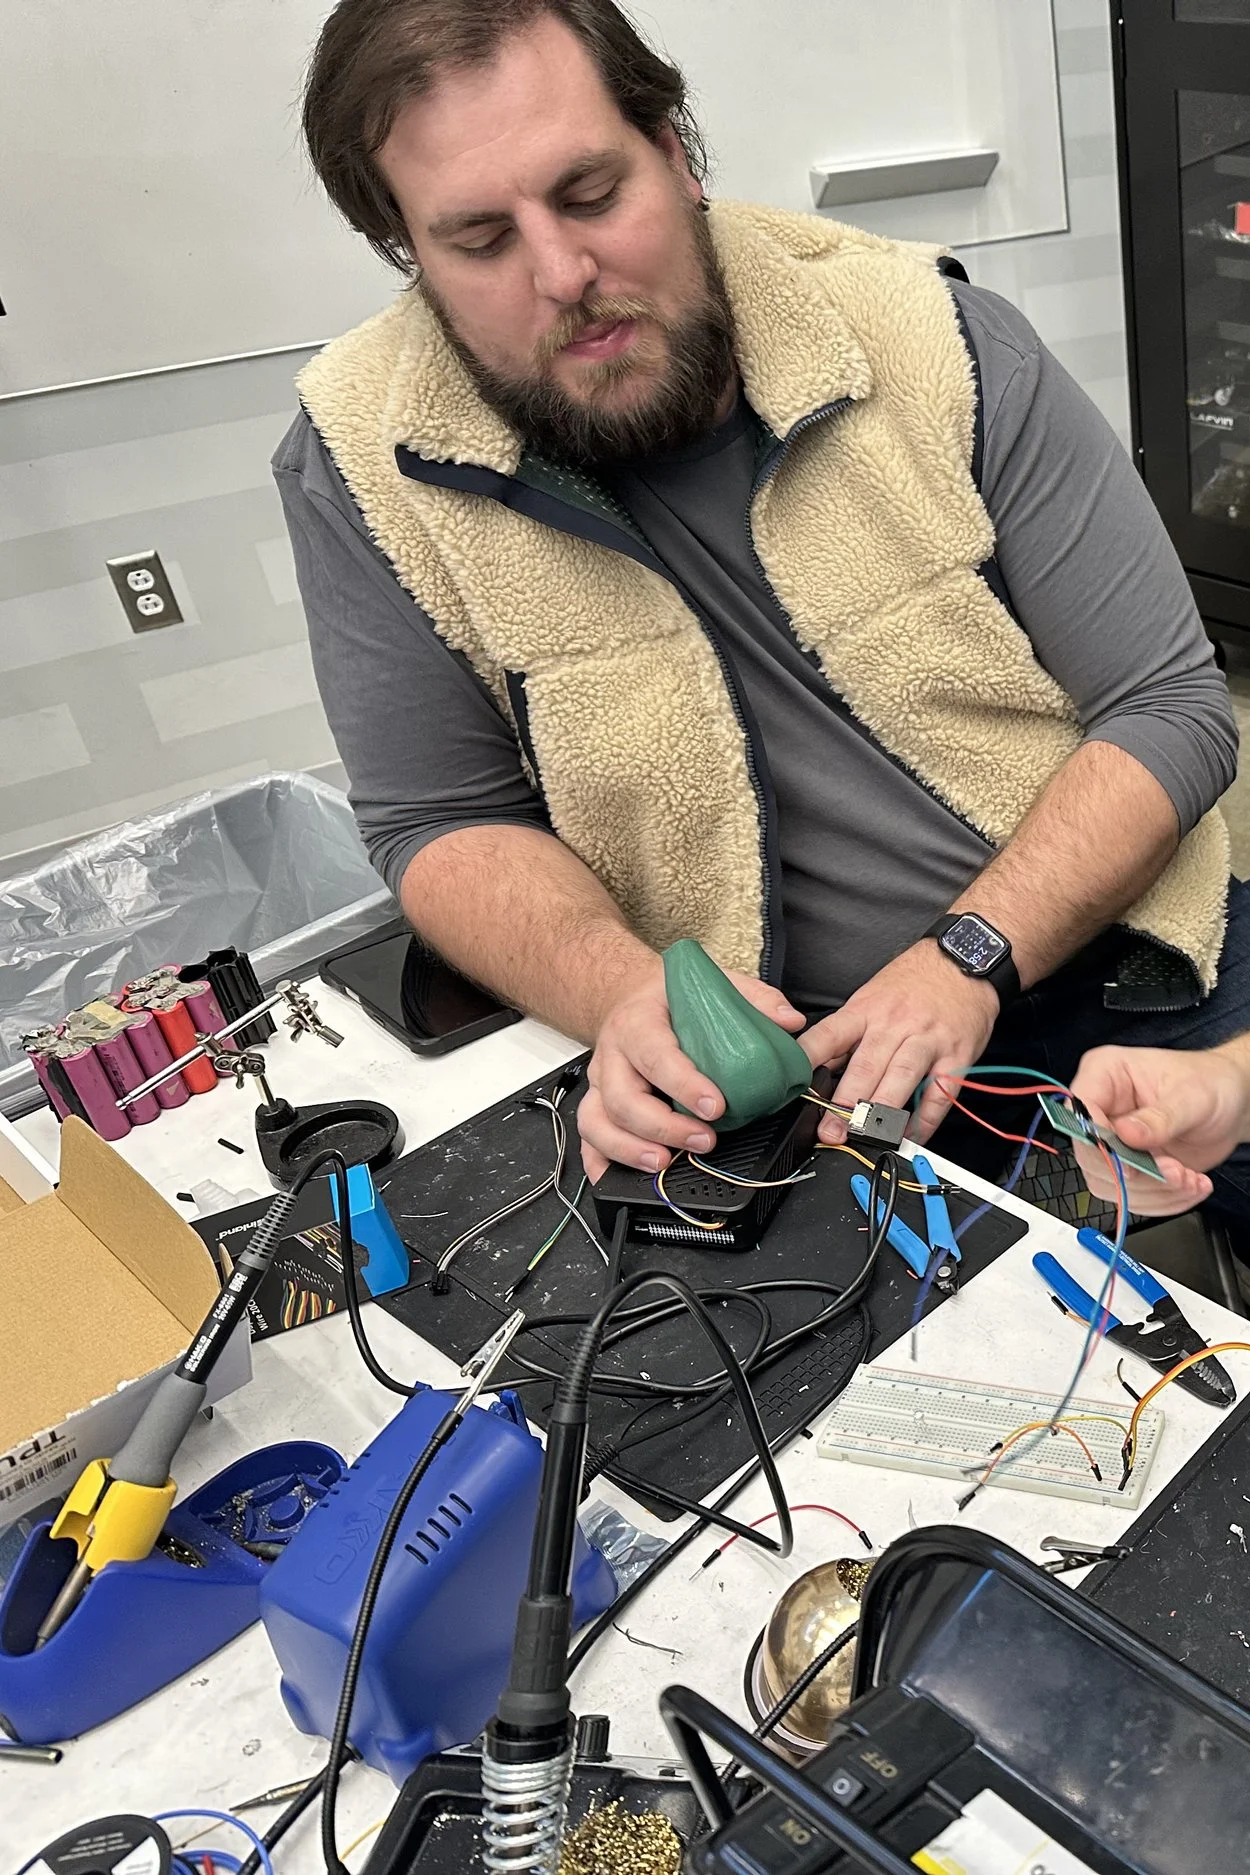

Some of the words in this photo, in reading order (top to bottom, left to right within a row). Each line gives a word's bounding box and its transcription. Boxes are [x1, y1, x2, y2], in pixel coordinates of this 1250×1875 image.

[969, 947, 988, 965] 2:58
[255, 1313, 269, 1331] Wire
[860, 1751, 898, 1778] OFF
[781, 1818, 812, 1845] ON
